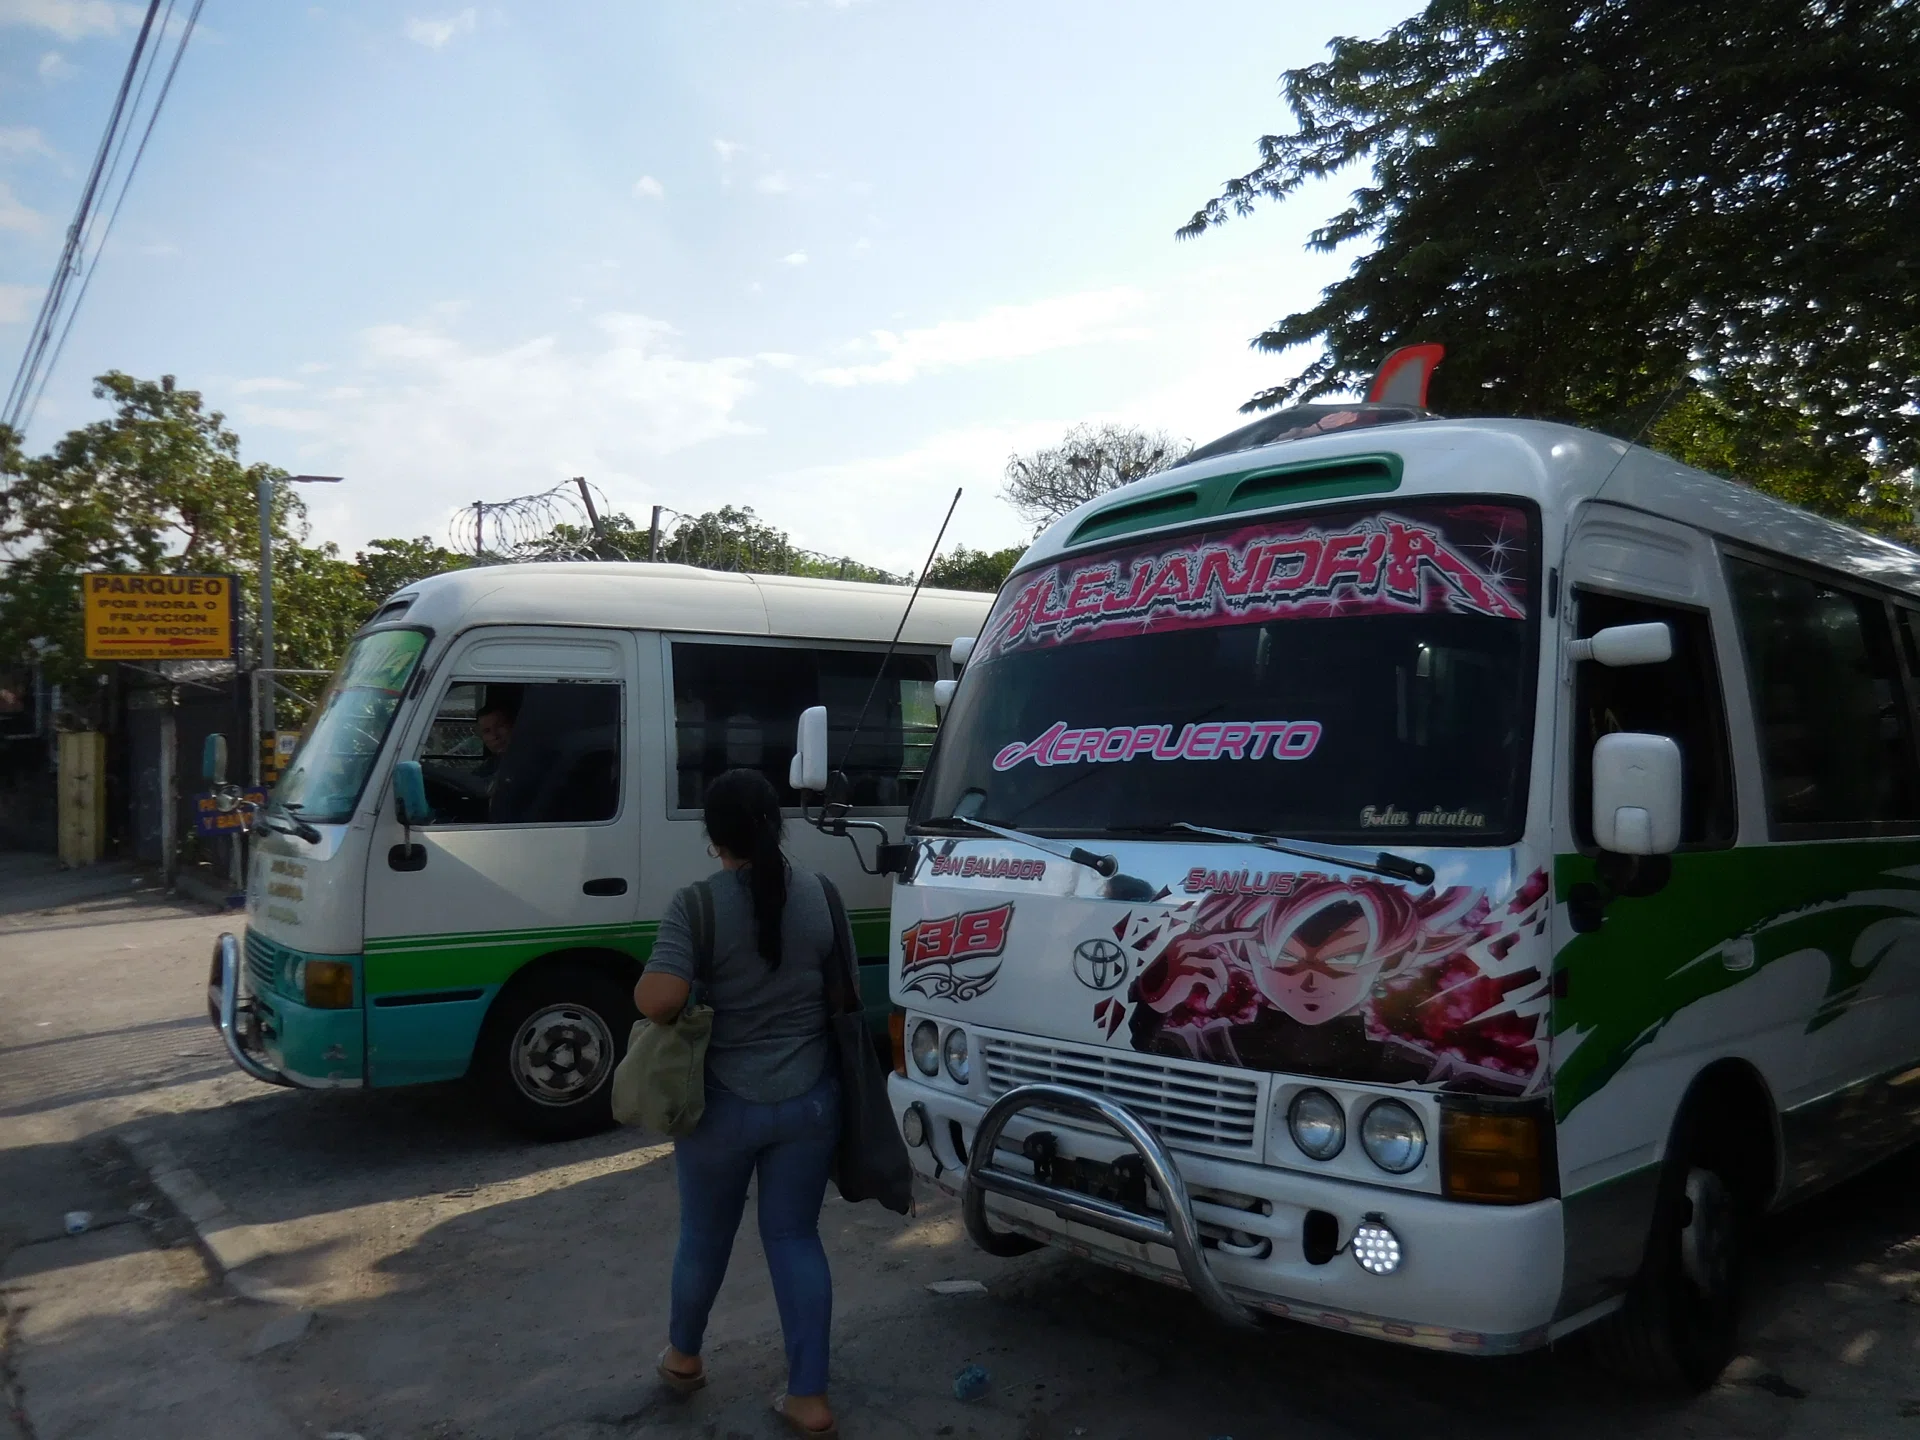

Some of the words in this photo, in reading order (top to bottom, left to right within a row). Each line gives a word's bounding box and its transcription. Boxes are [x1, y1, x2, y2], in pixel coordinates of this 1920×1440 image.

[93, 577, 222, 595] PARQUEO
[972, 516, 1527, 664] ALEJANDRA
[98, 600, 138, 608] POR
[145, 600, 198, 609] HORA
[204, 601, 217, 610] O
[109, 613, 207, 622] FRACCION
[97, 627, 130, 635] DIA
[137, 626, 148, 635] Y
[155, 627, 219, 635] NOCHE
[993, 721, 1322, 771] AEROPUERTO
[1416, 805, 1485, 827] mienten
[931, 856, 963, 876] SAN
[961, 856, 1046, 881] SALVADOR
[1184, 867, 1241, 895] SAN
[1238, 869, 1297, 897] LUIS
[901, 901, 1015, 978] 138
